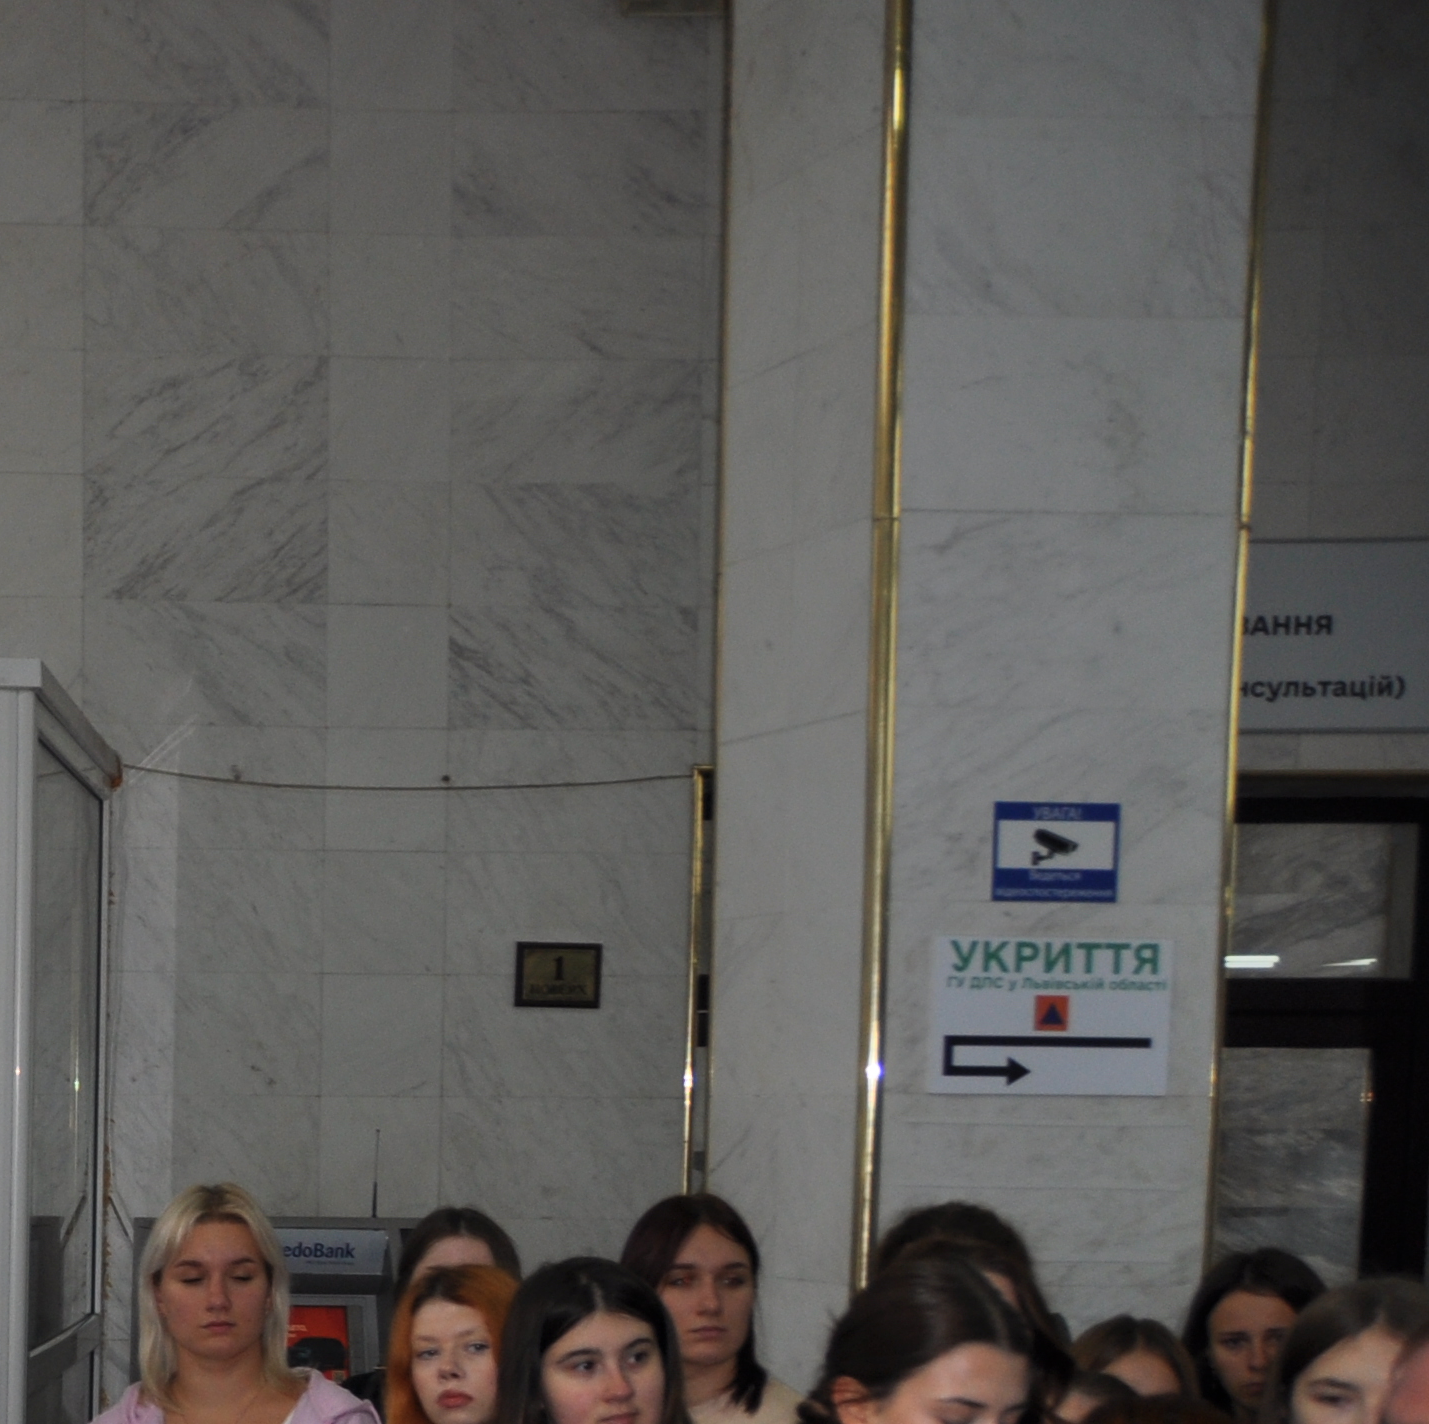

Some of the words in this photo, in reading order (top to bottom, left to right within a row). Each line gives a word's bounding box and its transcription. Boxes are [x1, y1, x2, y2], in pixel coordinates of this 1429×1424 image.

[1033, 806, 1083, 820] УВАГА!
[949, 939, 1161, 975] УКРИТТЯ
[552, 956, 565, 981] 1
[946, 976, 966, 989] ГУ
[969, 976, 1004, 990] ДПС
[1008, 979, 1017, 992] у
[1021, 976, 1105, 990] Львівській
[1108, 978, 1168, 991] області
